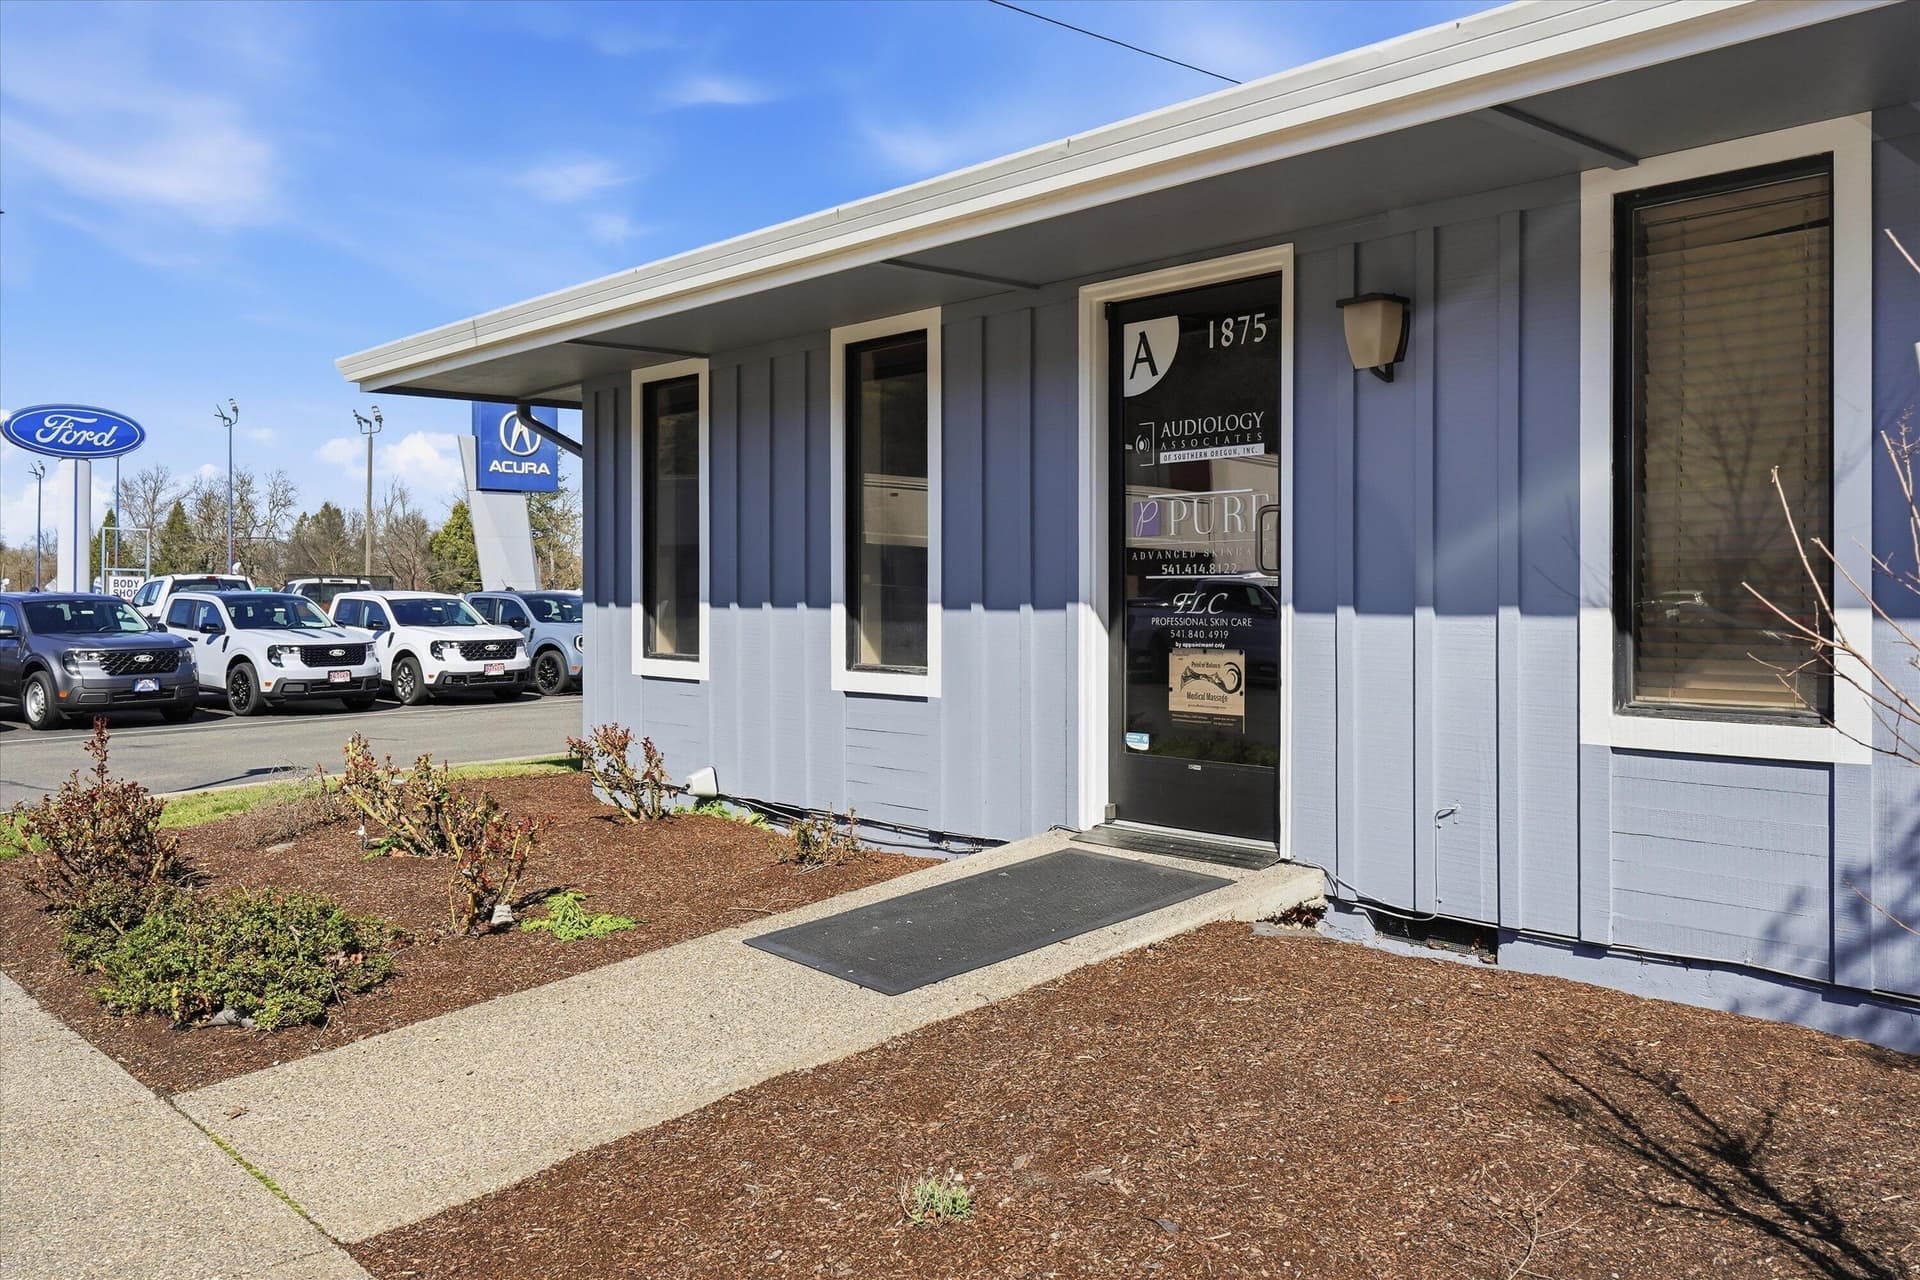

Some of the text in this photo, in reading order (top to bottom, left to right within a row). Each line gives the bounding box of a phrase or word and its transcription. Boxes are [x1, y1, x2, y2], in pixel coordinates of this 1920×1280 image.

[1209, 313, 1267, 348] 1875
[1129, 330, 1159, 380] A
[35, 414, 118, 447] Ford
[1160, 411, 1265, 438] AUDIOLOGY
[1161, 432, 1262, 451] ASSOCIATES
[1174, 450, 1208, 461] SOUTHERN
[489, 460, 551, 475] ACURA
[1170, 494, 1271, 536] PURE
[1132, 549, 1197, 561] ADVANCED
[1161, 563, 1238, 575] 541.414.8122
[113, 579, 139, 588] BODY
[1151, 617, 1252, 627] PROFESSIONAL SKIN CARE
[1170, 629, 1229, 639] 541.840.4919
[1175, 641, 1182, 649] by
[1214, 642, 1225, 650] only
[1186, 691, 1228, 703] Medical Massage
